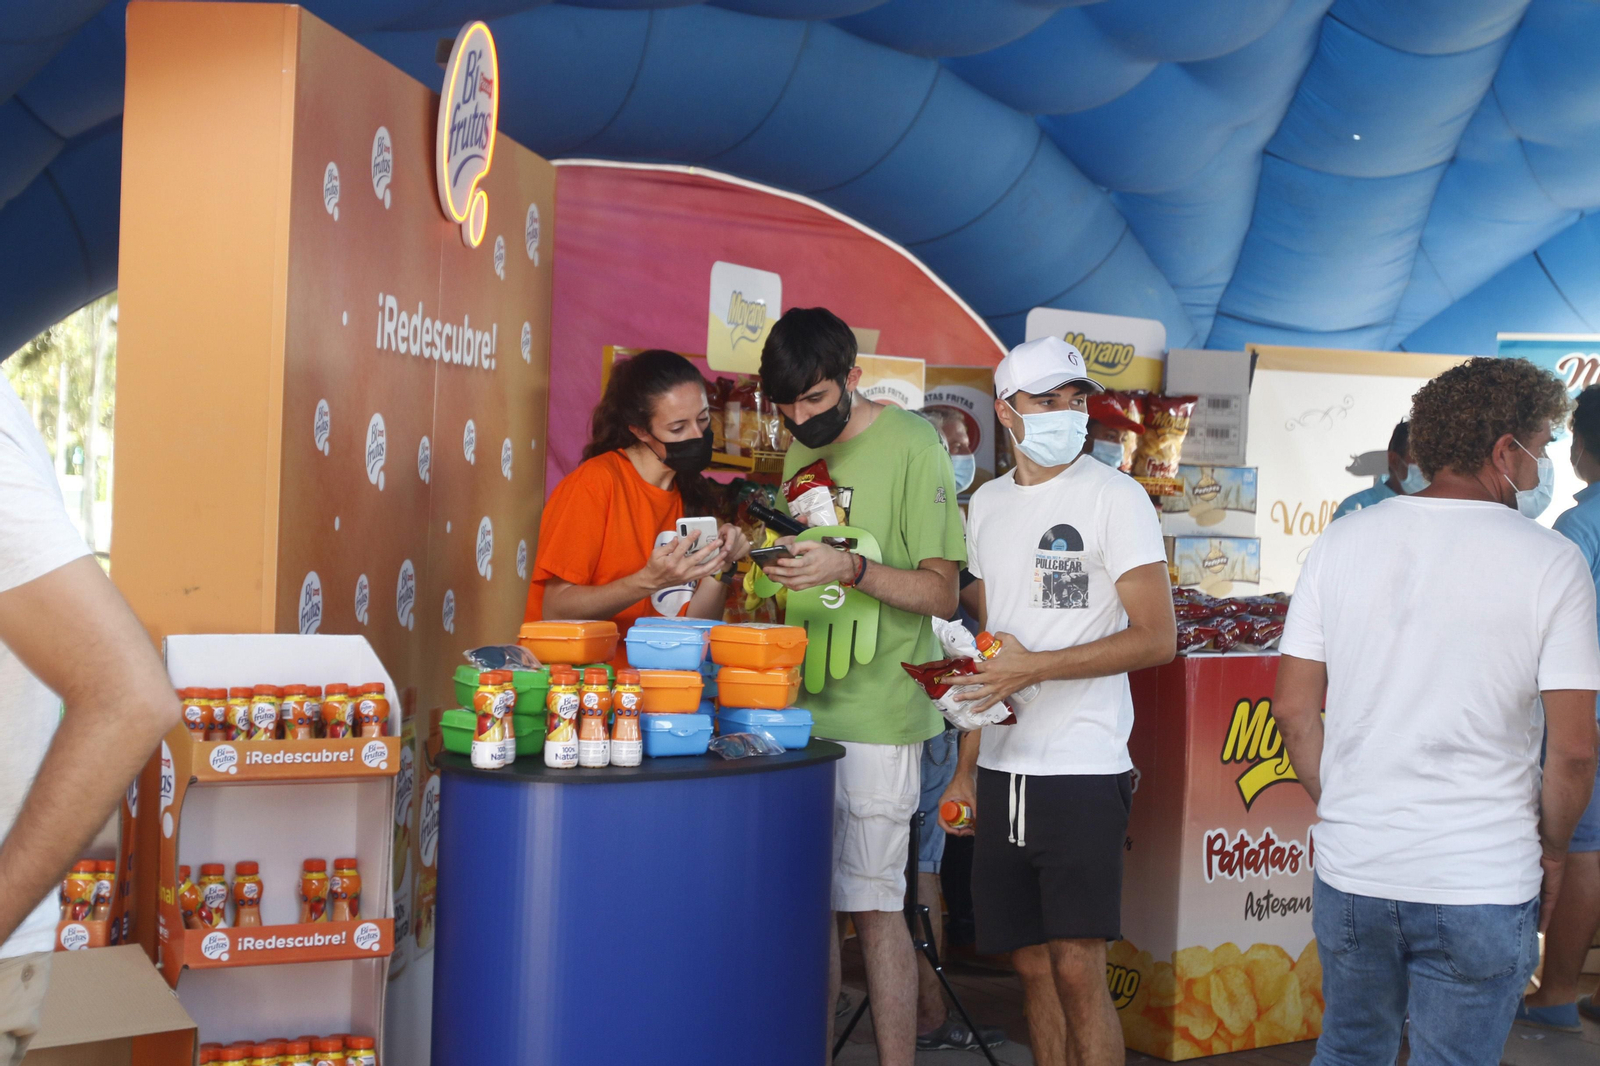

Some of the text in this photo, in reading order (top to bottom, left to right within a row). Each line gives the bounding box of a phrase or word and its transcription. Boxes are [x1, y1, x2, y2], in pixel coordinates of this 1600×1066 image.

[447, 101, 491, 163] frutas
[727, 290, 767, 333] Moyano
[376, 292, 497, 370] ¡Redescubre!
[1064, 331, 1136, 368] Moyano
[863, 386, 909, 405] ATATAS FRITAS
[945, 393, 974, 410] FRITAS
[1035, 557, 1082, 573] PULL&BEAR
[301, 600, 321, 633] frutas
[254, 711, 275, 723] frutas
[212, 753, 236, 767] frutas
[246, 748, 355, 765] ¡Redescubre!
[364, 750, 386, 762] frutas
[1205, 830, 1304, 881] Patatas
[205, 892, 225, 903] frutas
[63, 932, 87, 944] frutas
[237, 931, 347, 951] ¡Redescubre!
[356, 932, 379, 944] frutas
[204, 941, 228, 954] frutas
